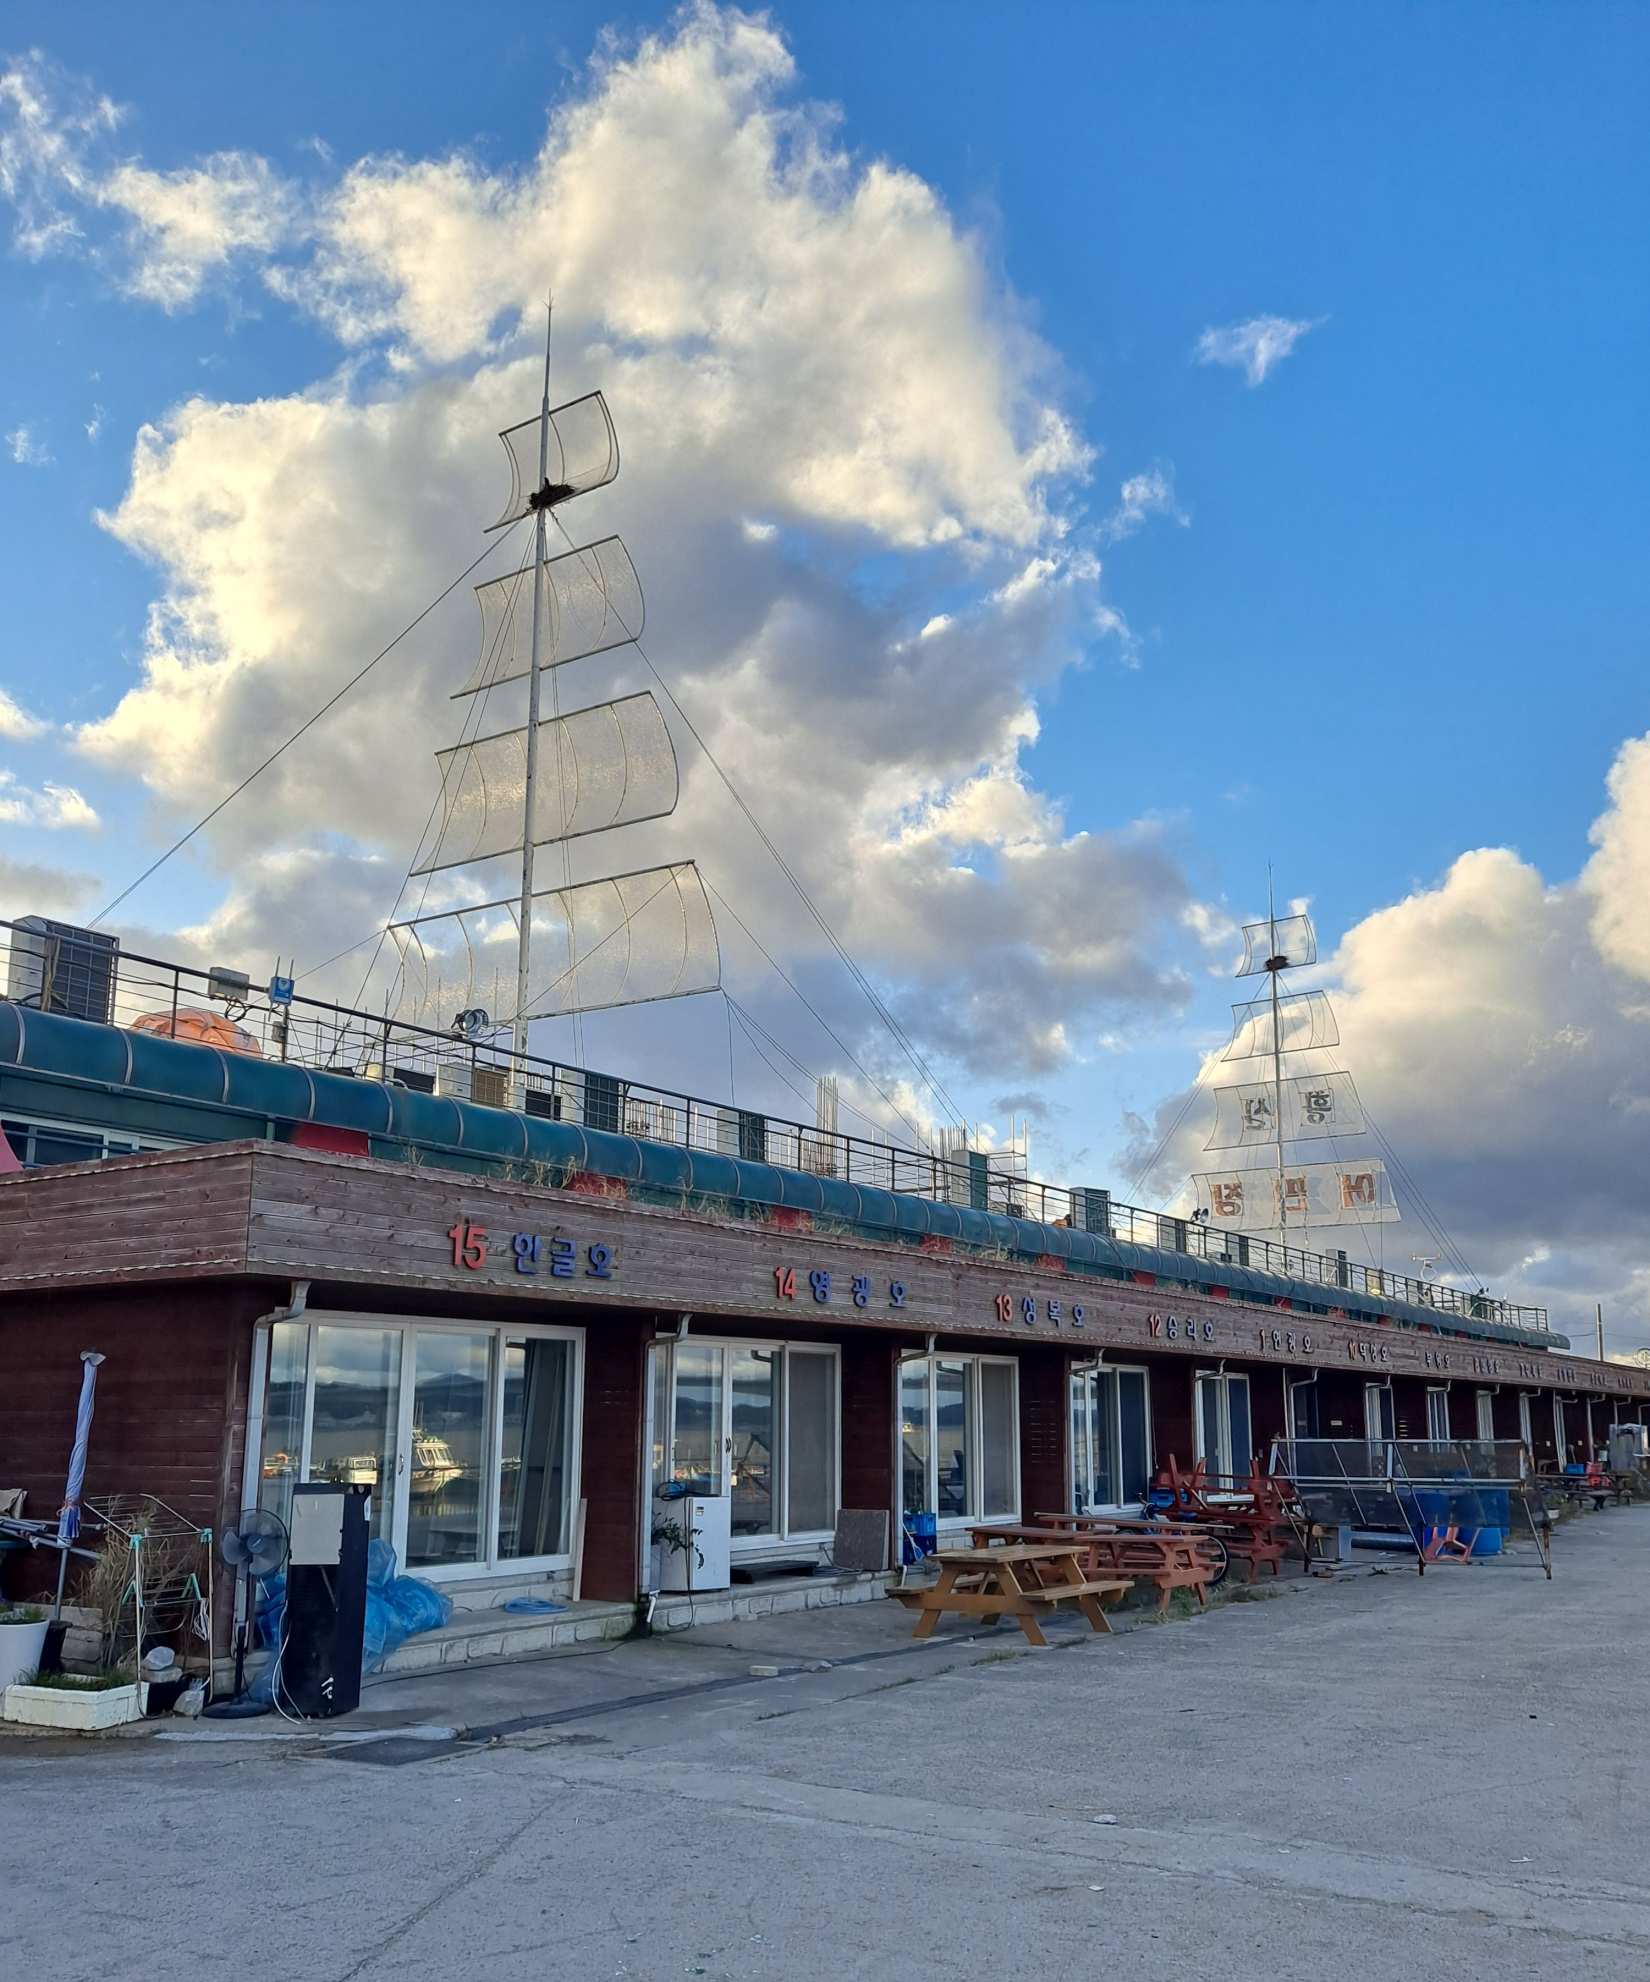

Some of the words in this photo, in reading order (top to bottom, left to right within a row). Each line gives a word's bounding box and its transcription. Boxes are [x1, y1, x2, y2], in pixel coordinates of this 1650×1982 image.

[448, 1223, 488, 1270] 15
[774, 1265, 797, 1301] 14
[995, 1295, 1013, 1322] 13
[1148, 1314, 1162, 1337] 12
